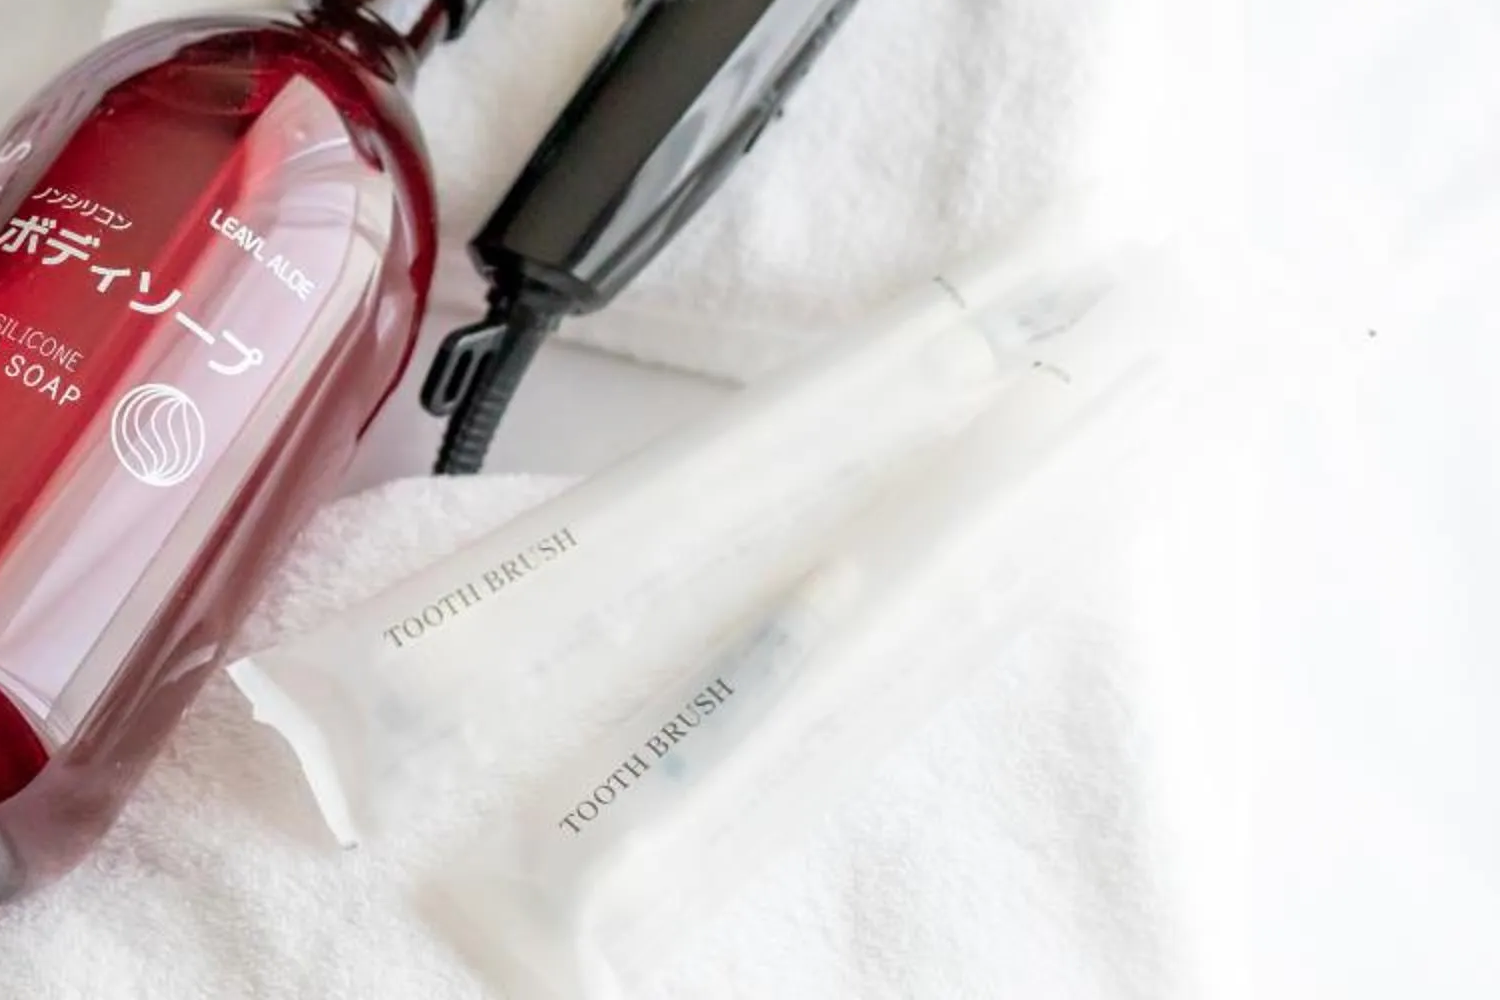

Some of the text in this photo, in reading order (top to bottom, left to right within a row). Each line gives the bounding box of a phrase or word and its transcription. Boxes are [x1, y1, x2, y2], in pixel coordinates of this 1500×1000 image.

[32, 186, 134, 231] ノンシリコン
[5, 354, 82, 407] SOAP
[383, 527, 579, 649] TOOTH BRUSH
[558, 676, 736, 837] TOOTH BRUSH
